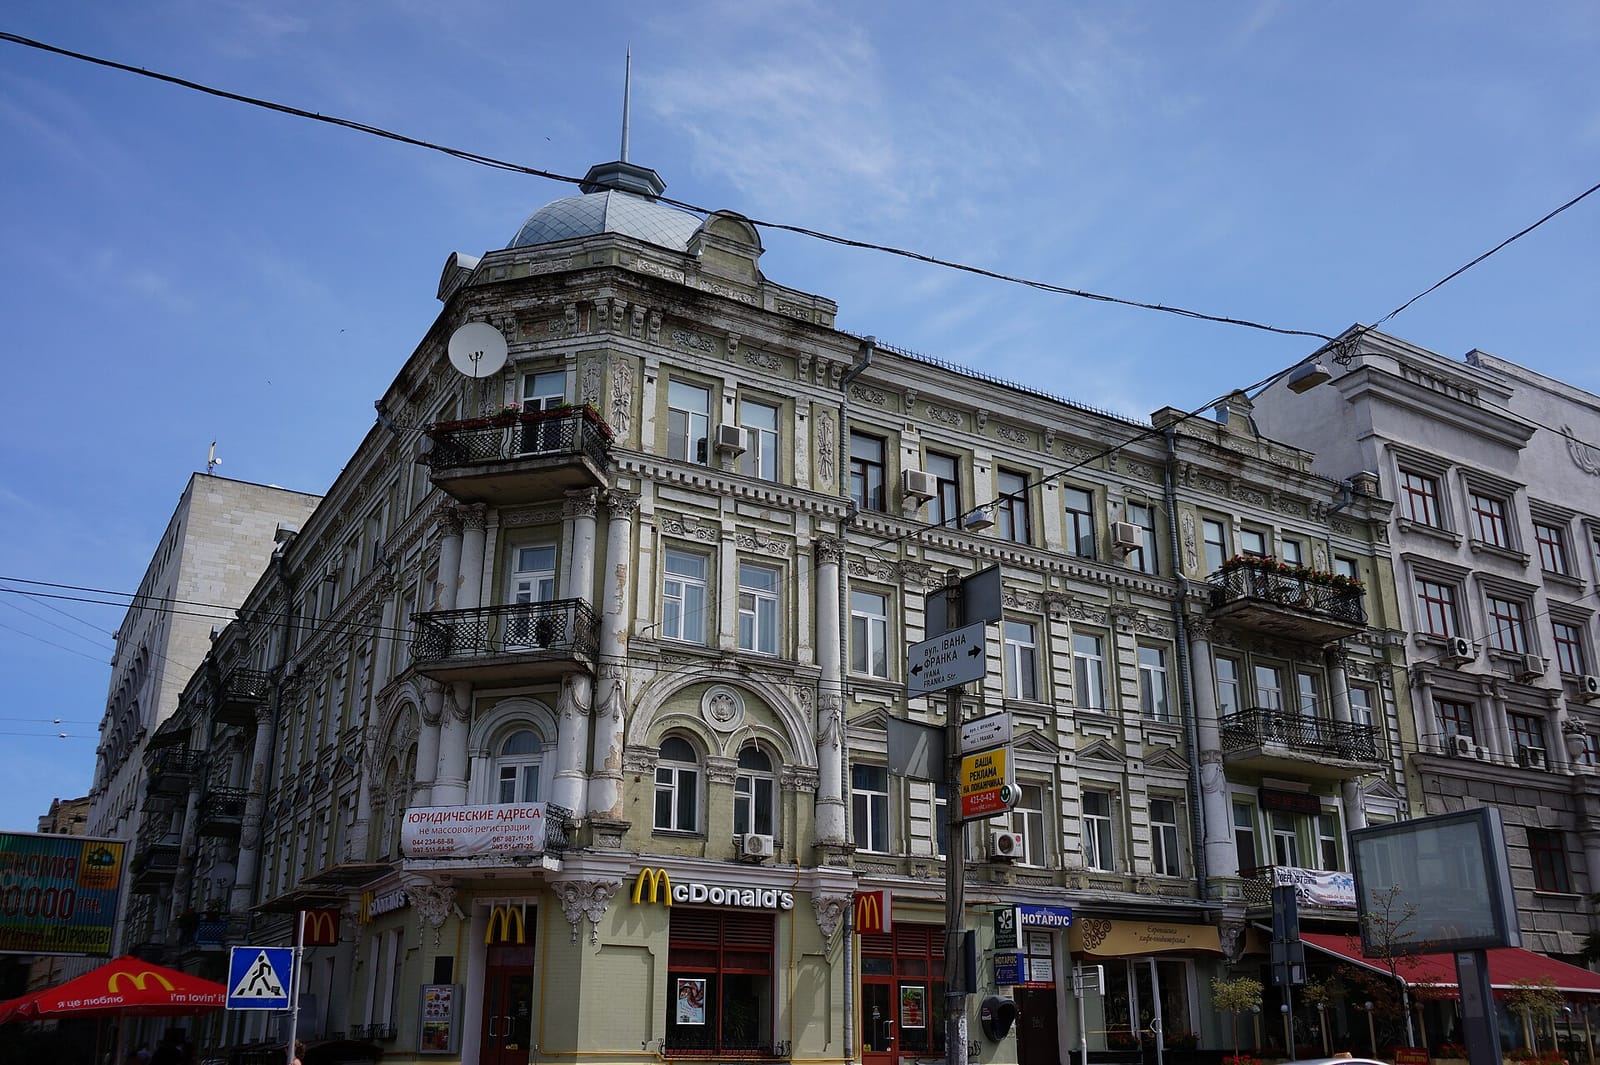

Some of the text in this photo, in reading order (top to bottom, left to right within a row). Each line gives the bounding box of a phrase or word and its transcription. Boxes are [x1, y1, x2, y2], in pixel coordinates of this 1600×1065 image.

[924, 634, 967, 658] вул. ІВАНА
[924, 650, 958, 668] ФРАНКА
[923, 669, 940, 680] IVANA
[923, 672, 958, 688] FRANKA Str.
[974, 756, 992, 769] ВАША
[969, 766, 997, 782] РЕКЛАМА
[408, 808, 541, 824] ЮРИДИЧЕСКИЕ АДРЕСА
[419, 824, 530, 835] не массовой регистрации
[632, 867, 794, 910] McDonald's
[1022, 913, 1070, 926] НОТАРІУС
[67, 999, 81, 1008] це
[83, 996, 124, 1006] люблю
[170, 993, 226, 1003] i'm lovin' it
